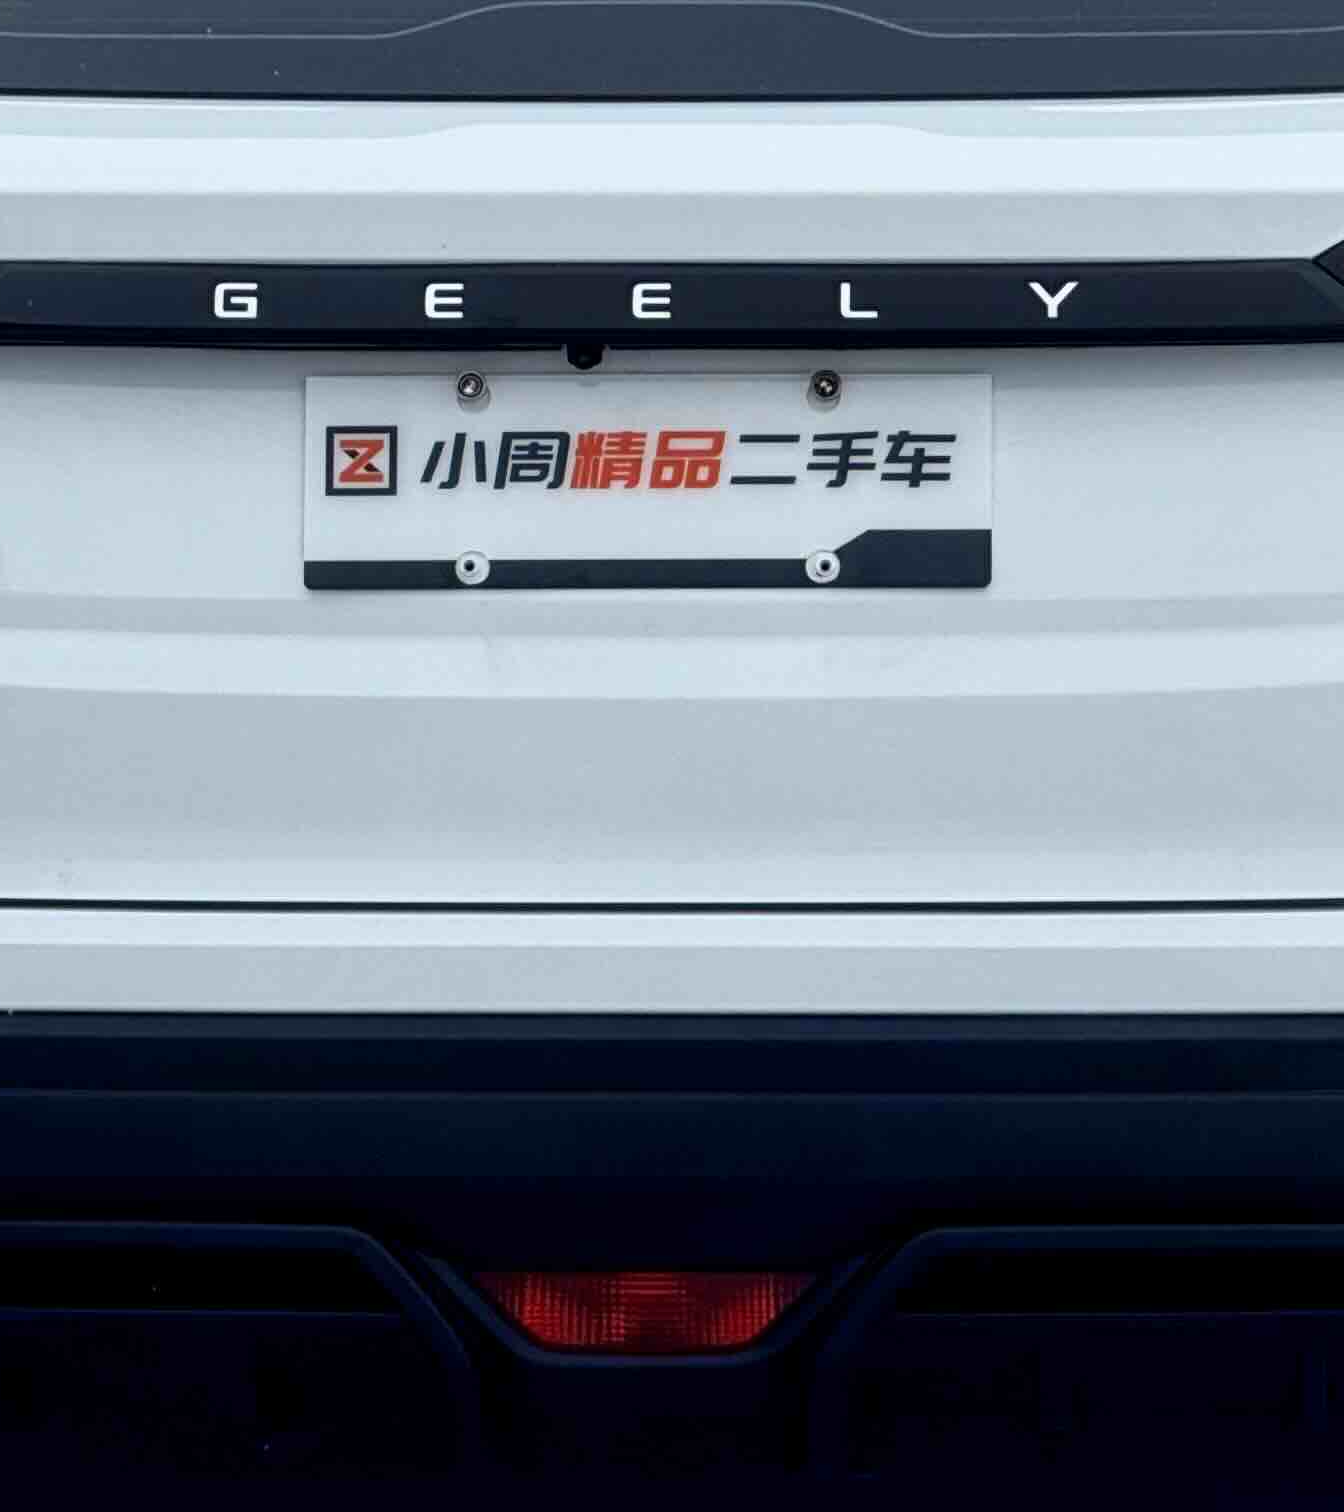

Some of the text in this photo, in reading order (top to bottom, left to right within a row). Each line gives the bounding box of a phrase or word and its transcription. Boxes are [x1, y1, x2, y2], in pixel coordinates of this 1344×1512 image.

[214, 281, 1078, 319] GEELY
[420, 429, 957, 490] 小周精品二手车
